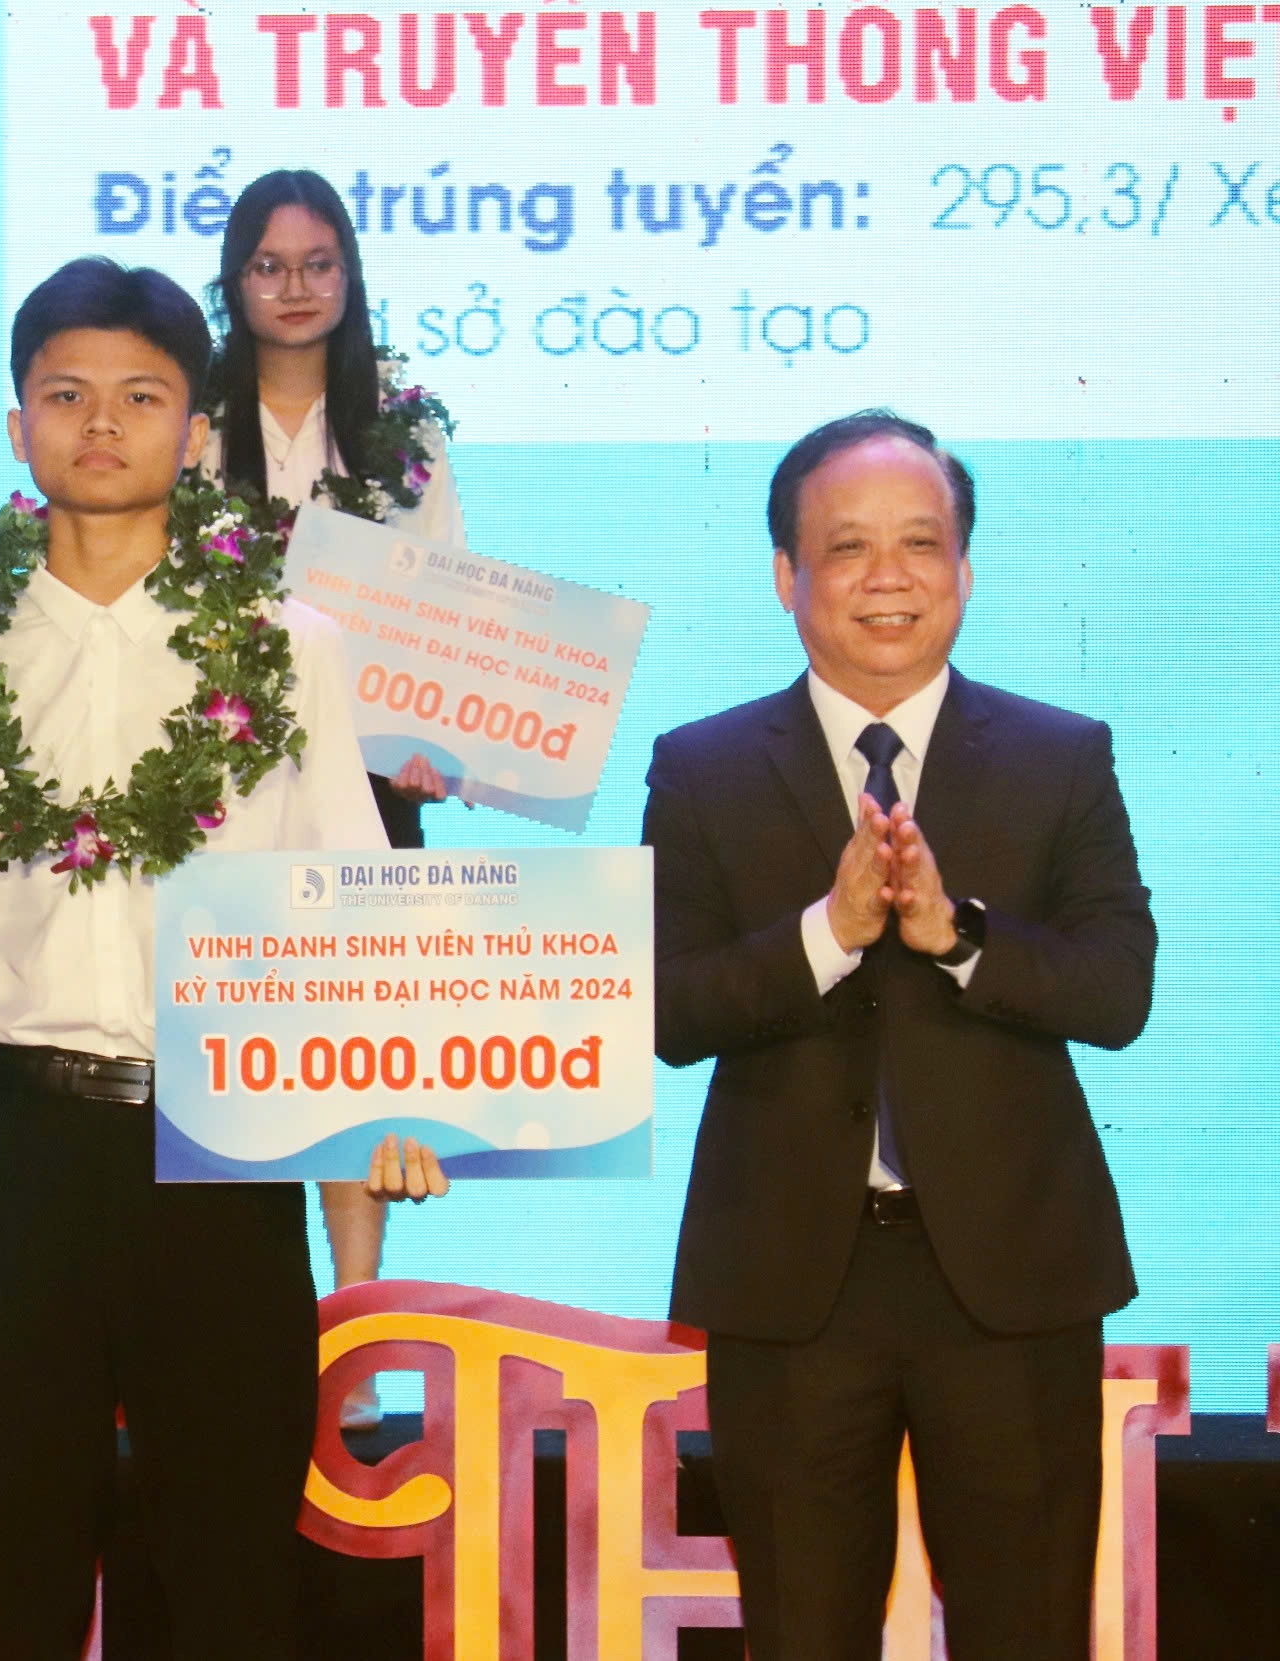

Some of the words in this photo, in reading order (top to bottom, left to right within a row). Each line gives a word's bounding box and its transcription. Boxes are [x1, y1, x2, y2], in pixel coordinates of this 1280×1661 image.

[94, 147, 232, 236] Điể
[348, 161, 575, 252] trúng
[606, 143, 870, 248] tuyển:
[930, 161, 1179, 237] 295,3/
[415, 281, 509, 357] sở
[533, 286, 701, 357] đào
[730, 288, 870, 368] tạo
[355, 582, 414, 613] DANH
[416, 600, 462, 628] SINH
[466, 611, 510, 643] VIÊN
[513, 629, 550, 654] THỦ
[554, 643, 610, 674] KHOA
[377, 622, 422, 650] SINH
[426, 638, 461, 664] ĐẠI
[464, 651, 509, 677] HỌC
[514, 664, 561, 693] NĂM
[563, 678, 610, 707] 2024
[358, 662, 578, 761] 000.000đ
[340, 865, 374, 891] ĐẠI
[380, 865, 421, 890] HỌC
[427, 860, 455, 885] ĐÀ
[461, 857, 518, 885] NẴNG
[340, 894, 366, 907] THE
[369, 894, 443, 907] UNIVERSITY
[464, 893, 519, 906] DANANG
[188, 936, 253, 959] VINH
[262, 935, 337, 958] DANH
[346, 934, 407, 957] SINH
[416, 927, 474, 957] VIÊN
[483, 926, 533, 956] THỦ
[542, 933, 619, 956] KHOA
[174, 976, 208, 1004] KỲ
[216, 968, 296, 1003] TUYỂN
[304, 980, 365, 1003] SINH
[374, 979, 419, 1008] ĐẠI
[429, 979, 491, 1008] HỌC
[499, 973, 561, 1000] NĂM
[569, 977, 633, 1000] 2024
[204, 1034, 604, 1092] 10.000.000đ
